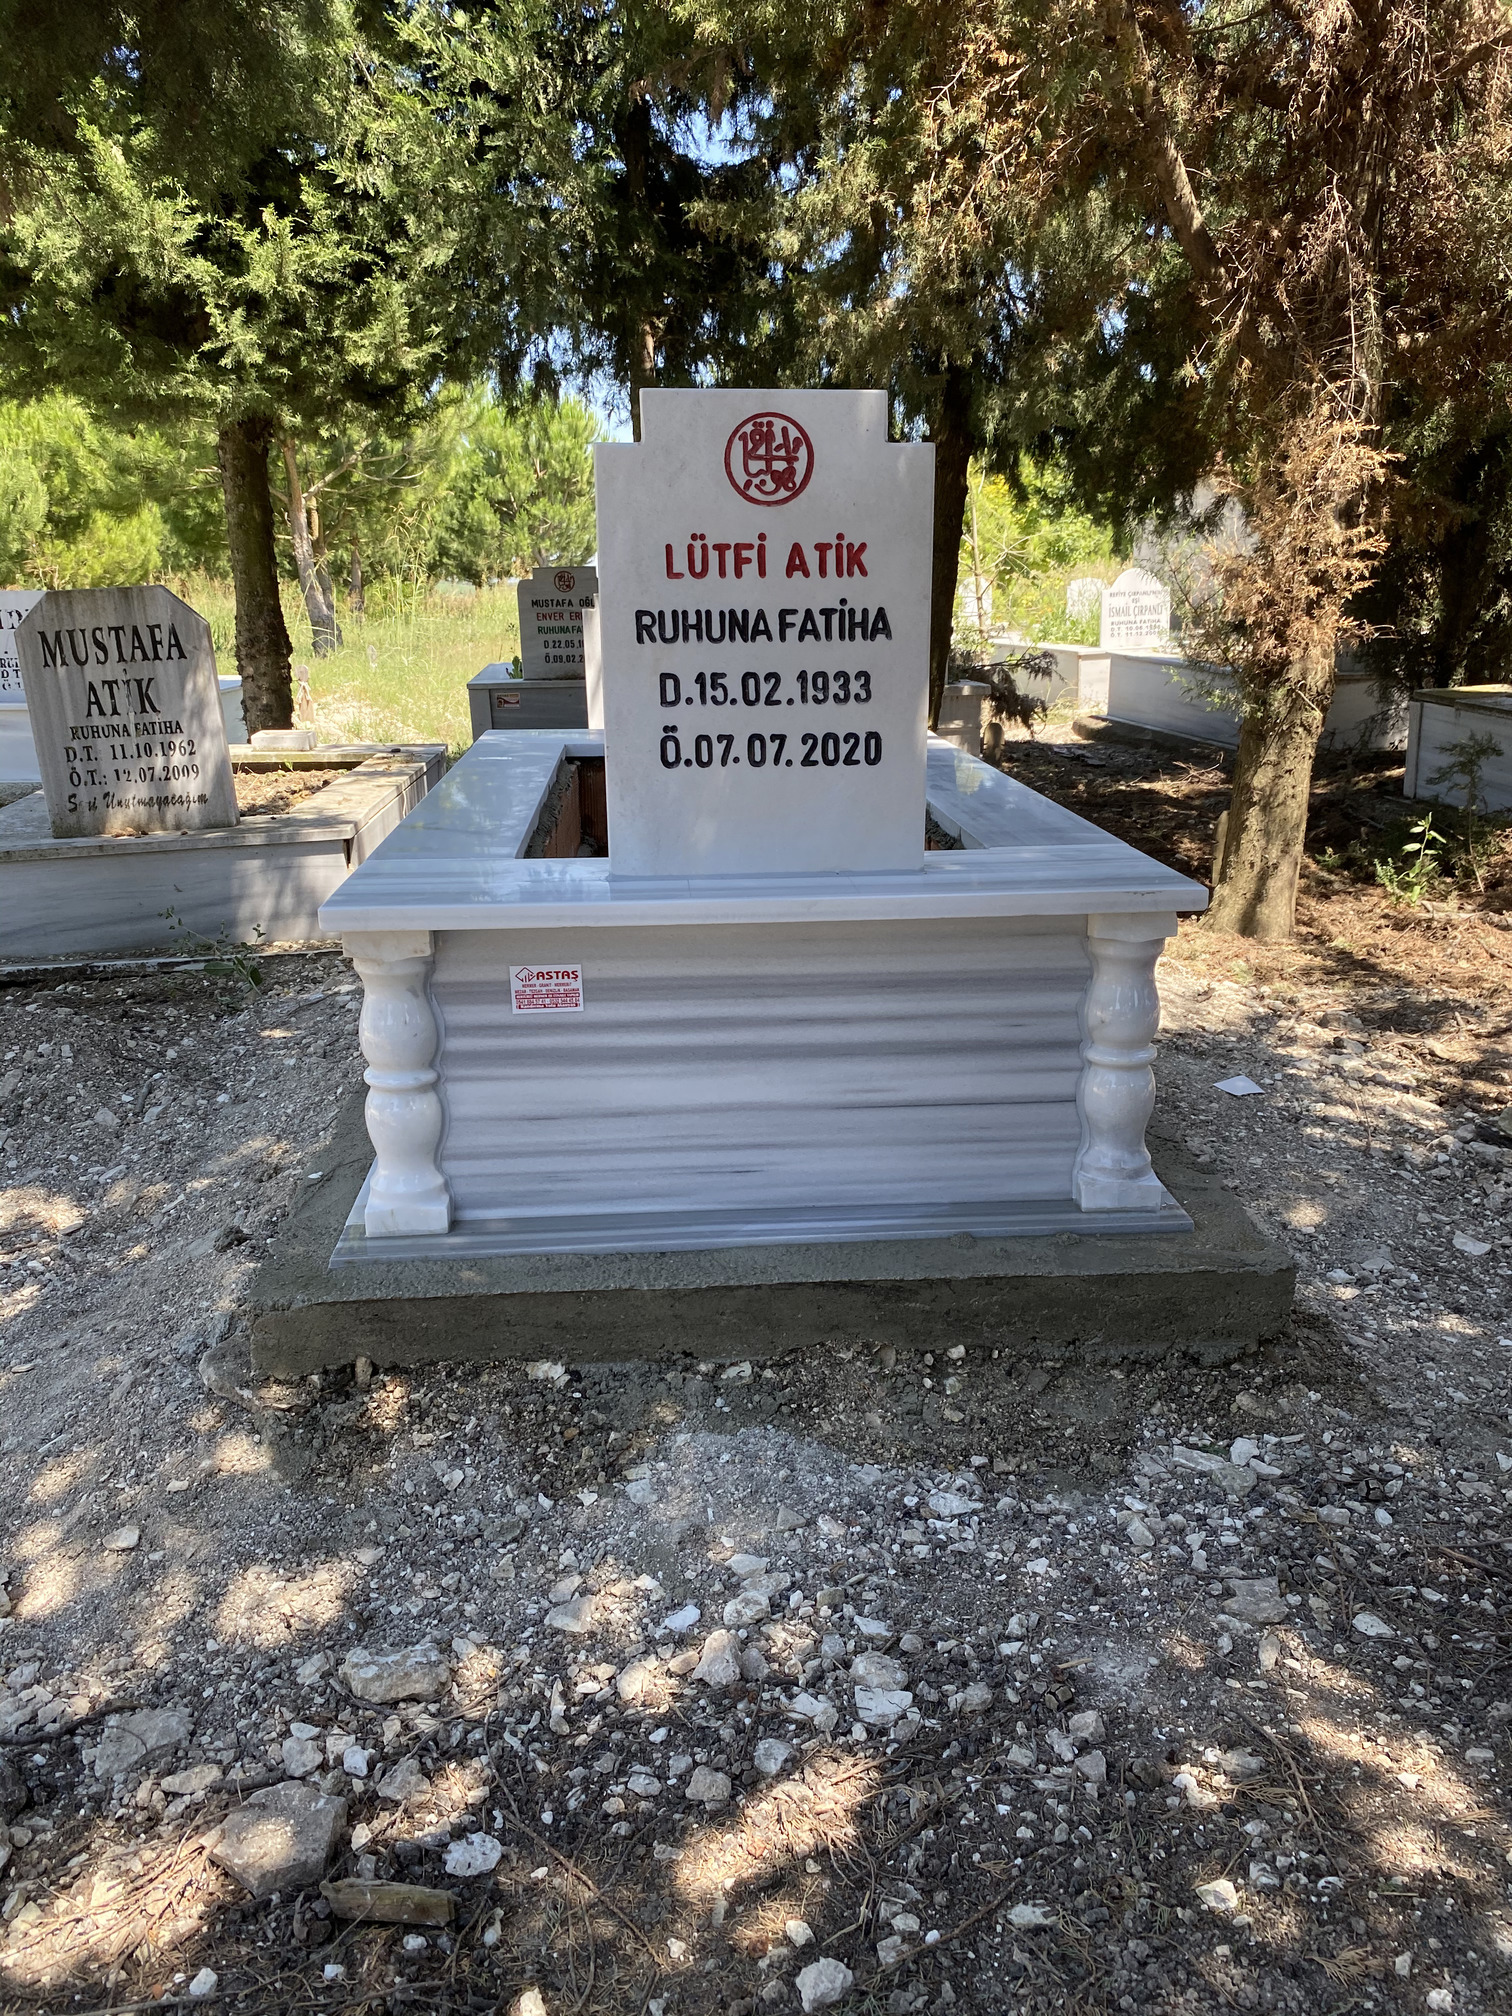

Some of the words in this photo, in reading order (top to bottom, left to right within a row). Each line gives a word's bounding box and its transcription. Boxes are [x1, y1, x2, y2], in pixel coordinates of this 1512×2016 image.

[665, 532, 767, 580] LÜTFİ
[785, 532, 869, 579] ATİK
[531, 598, 574, 608] MUSTAFA
[579, 596, 595, 607] OĞL
[1108, 603, 1132, 618] İSMAİL
[536, 612, 564, 621] ENVER
[635, 607, 773, 644] RUHUNA
[778, 597, 893, 643] FATİHA
[537, 625, 571, 635] RUHUNA
[571, 625, 584, 634] FA
[37, 622, 188, 668] MUSTAFA
[544, 654, 585, 664] Ö.09.02.2
[85, 668, 161, 718] ATİK
[659, 670, 873, 708] D.15.02.1933
[69, 723, 131, 741] RUHUNA
[133, 717, 184, 738] FATİHA
[110, 739, 197, 761] 11.10.1962
[660, 724, 883, 769] Ö.07.07.2020
[114, 763, 200, 784] 12.07.2009
[536, 970, 579, 982] ASTAŞ
